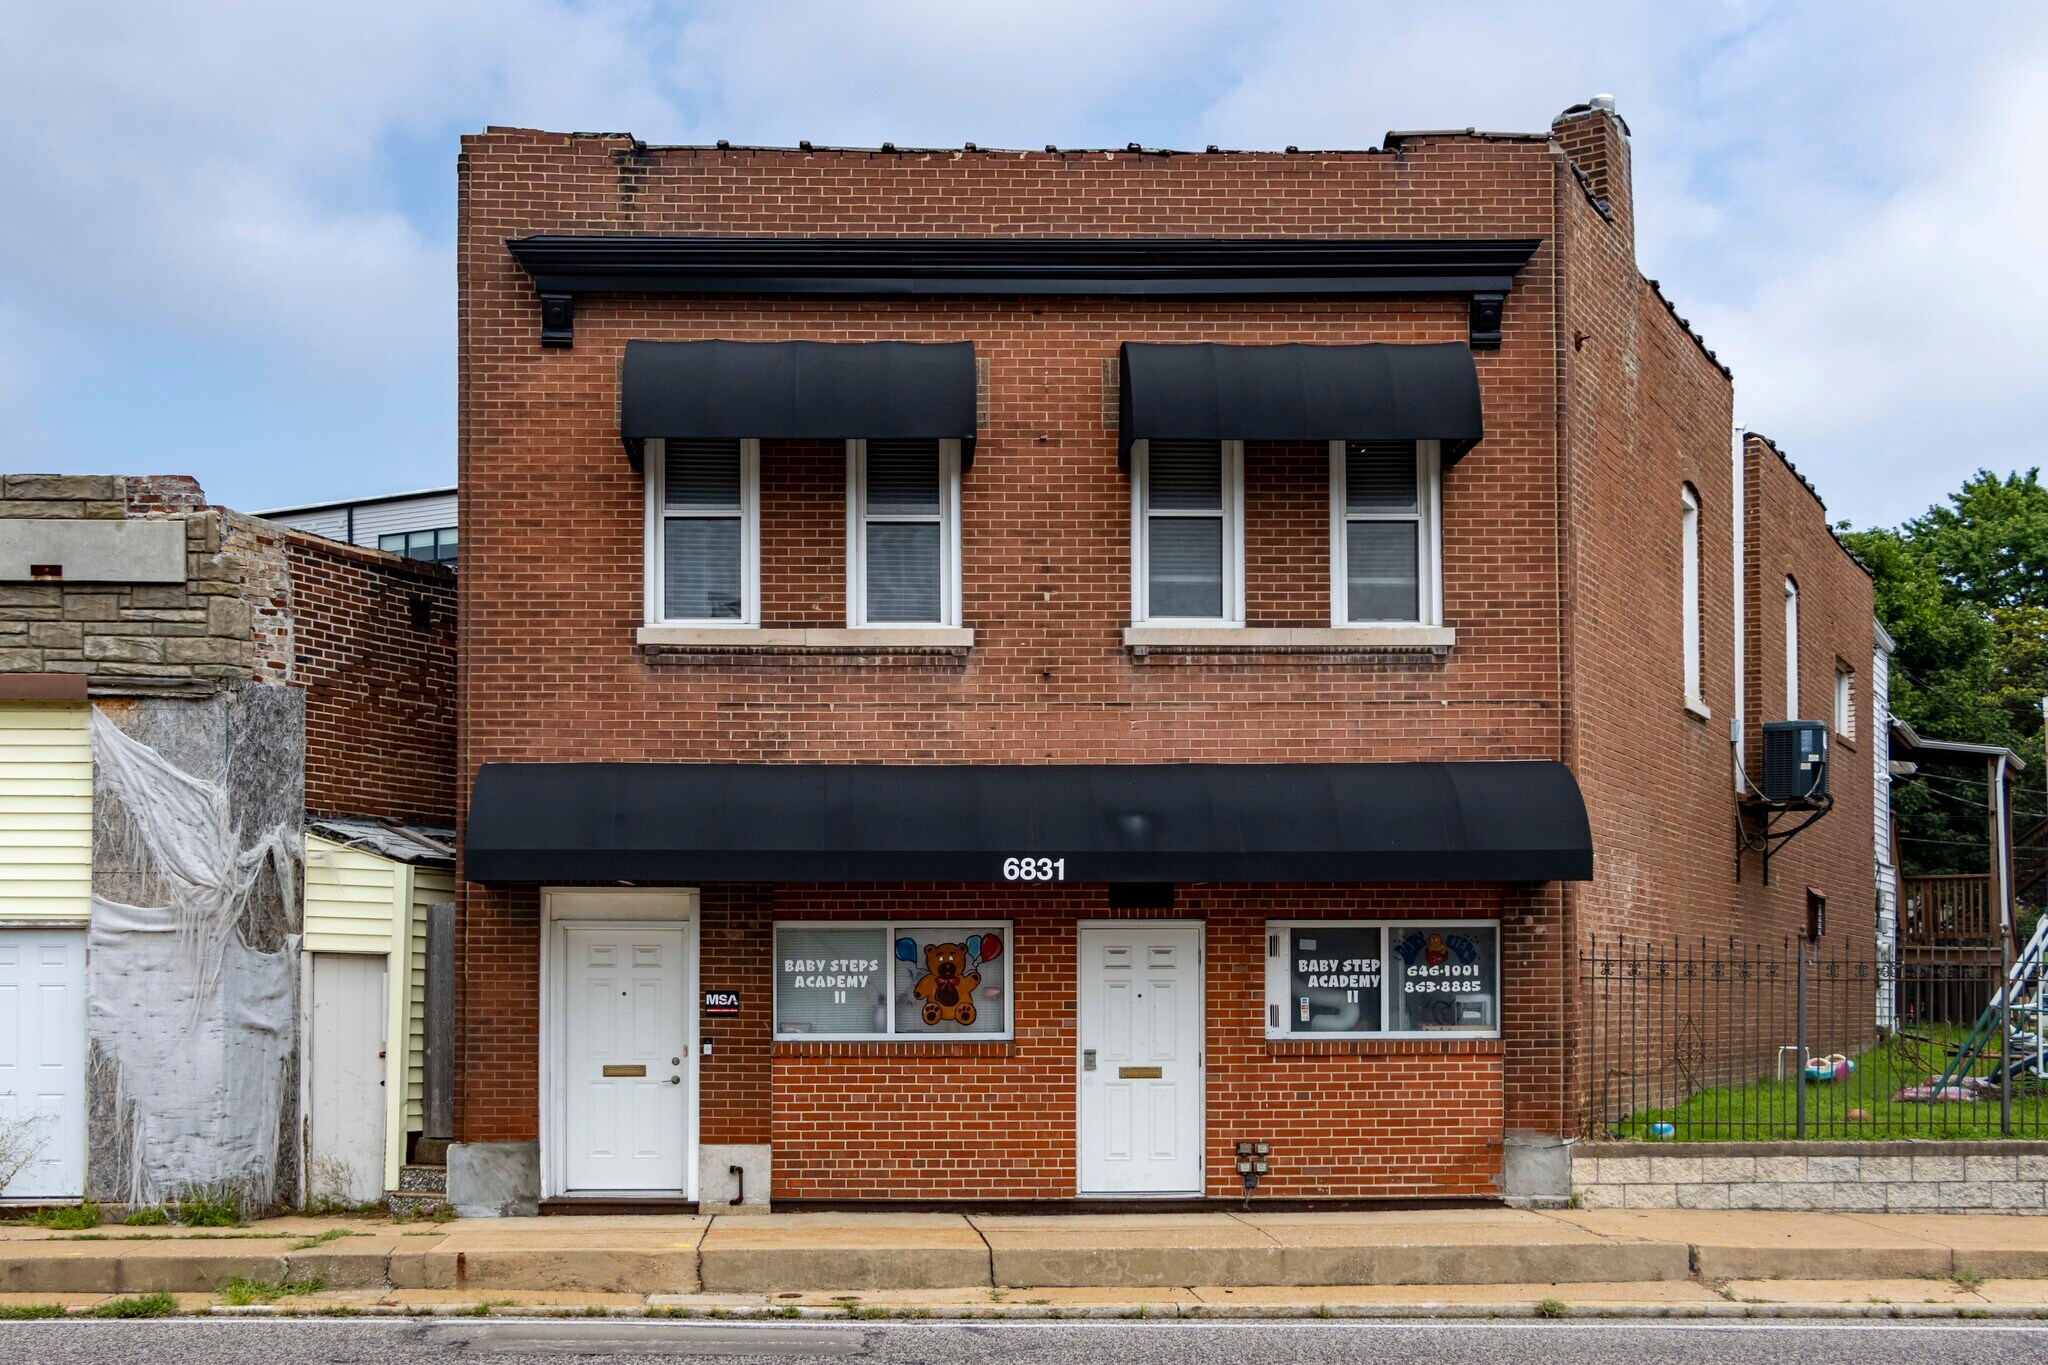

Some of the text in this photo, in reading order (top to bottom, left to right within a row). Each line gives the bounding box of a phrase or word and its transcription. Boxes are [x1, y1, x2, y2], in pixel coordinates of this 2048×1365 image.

[1003, 857, 1065, 881] 6831
[784, 959, 879, 972] BABY STEPS
[1298, 958, 1381, 973] BABY STEP
[794, 975, 868, 988] ACADEMY
[1307, 974, 1381, 988] ACADEMY
[705, 994, 739, 1006] MSA
